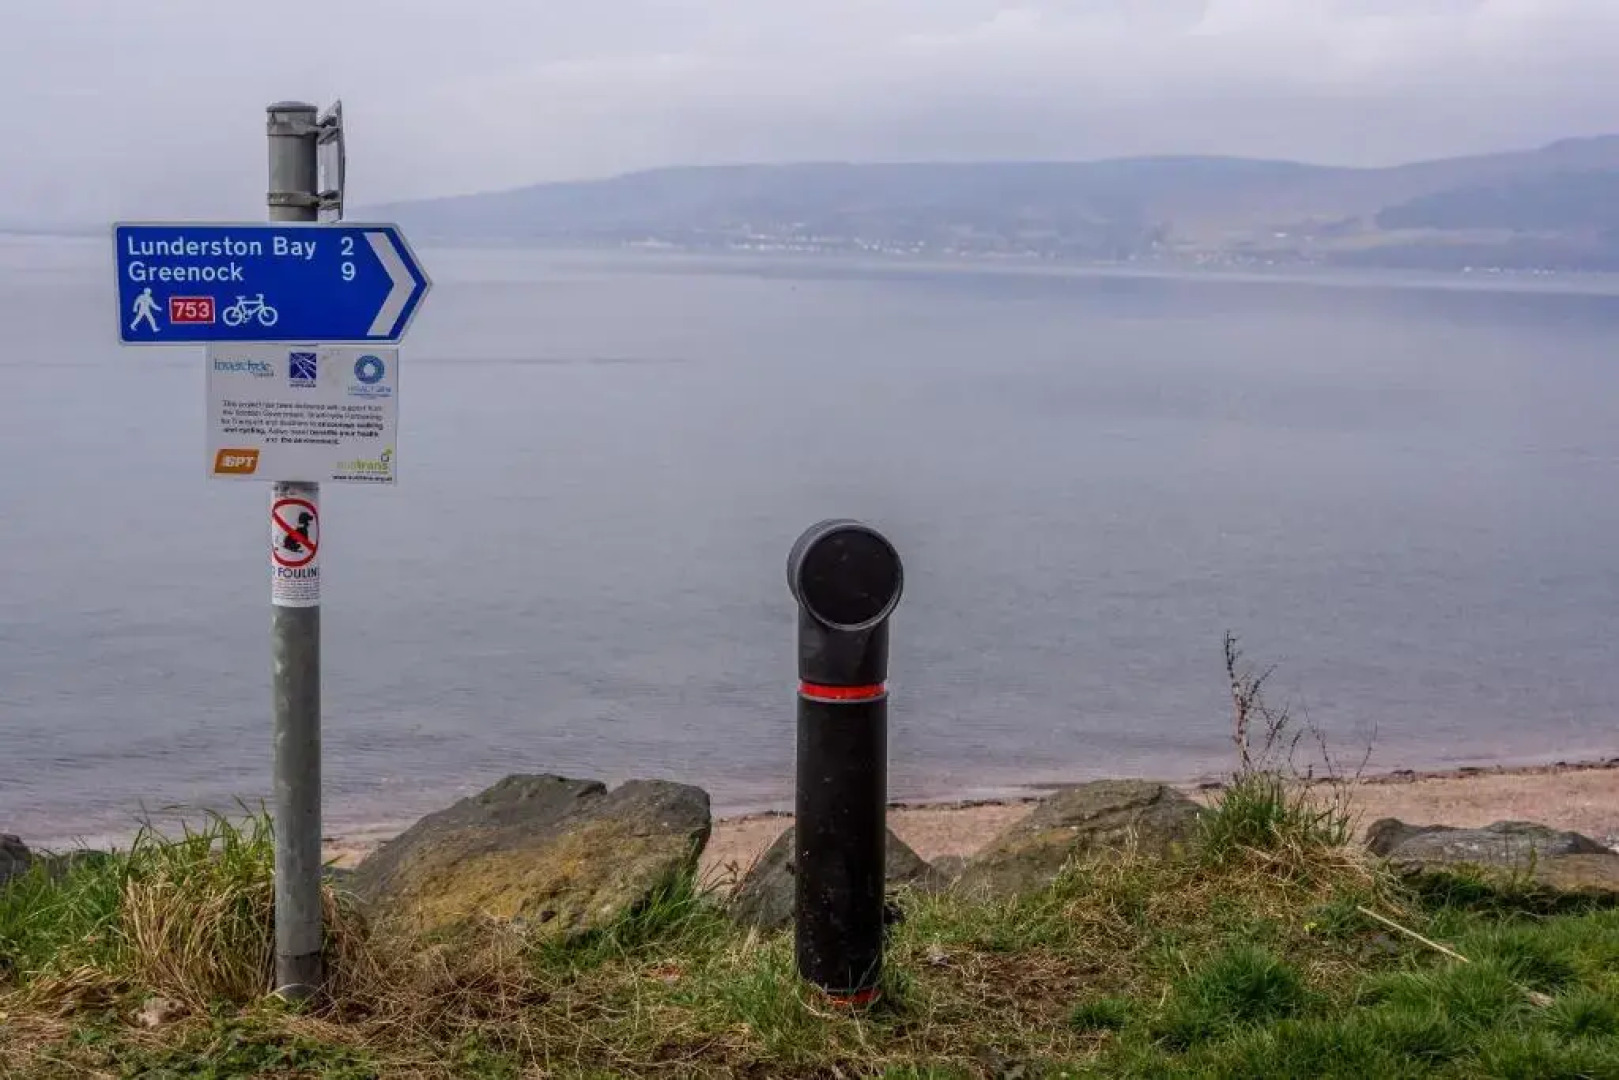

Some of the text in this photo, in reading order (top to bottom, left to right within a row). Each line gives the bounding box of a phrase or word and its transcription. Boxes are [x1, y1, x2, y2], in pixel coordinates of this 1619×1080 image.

[127, 235, 355, 260] Lunderston Bay 2
[127, 261, 356, 282] Greenock 9
[173, 301, 210, 318] 753
